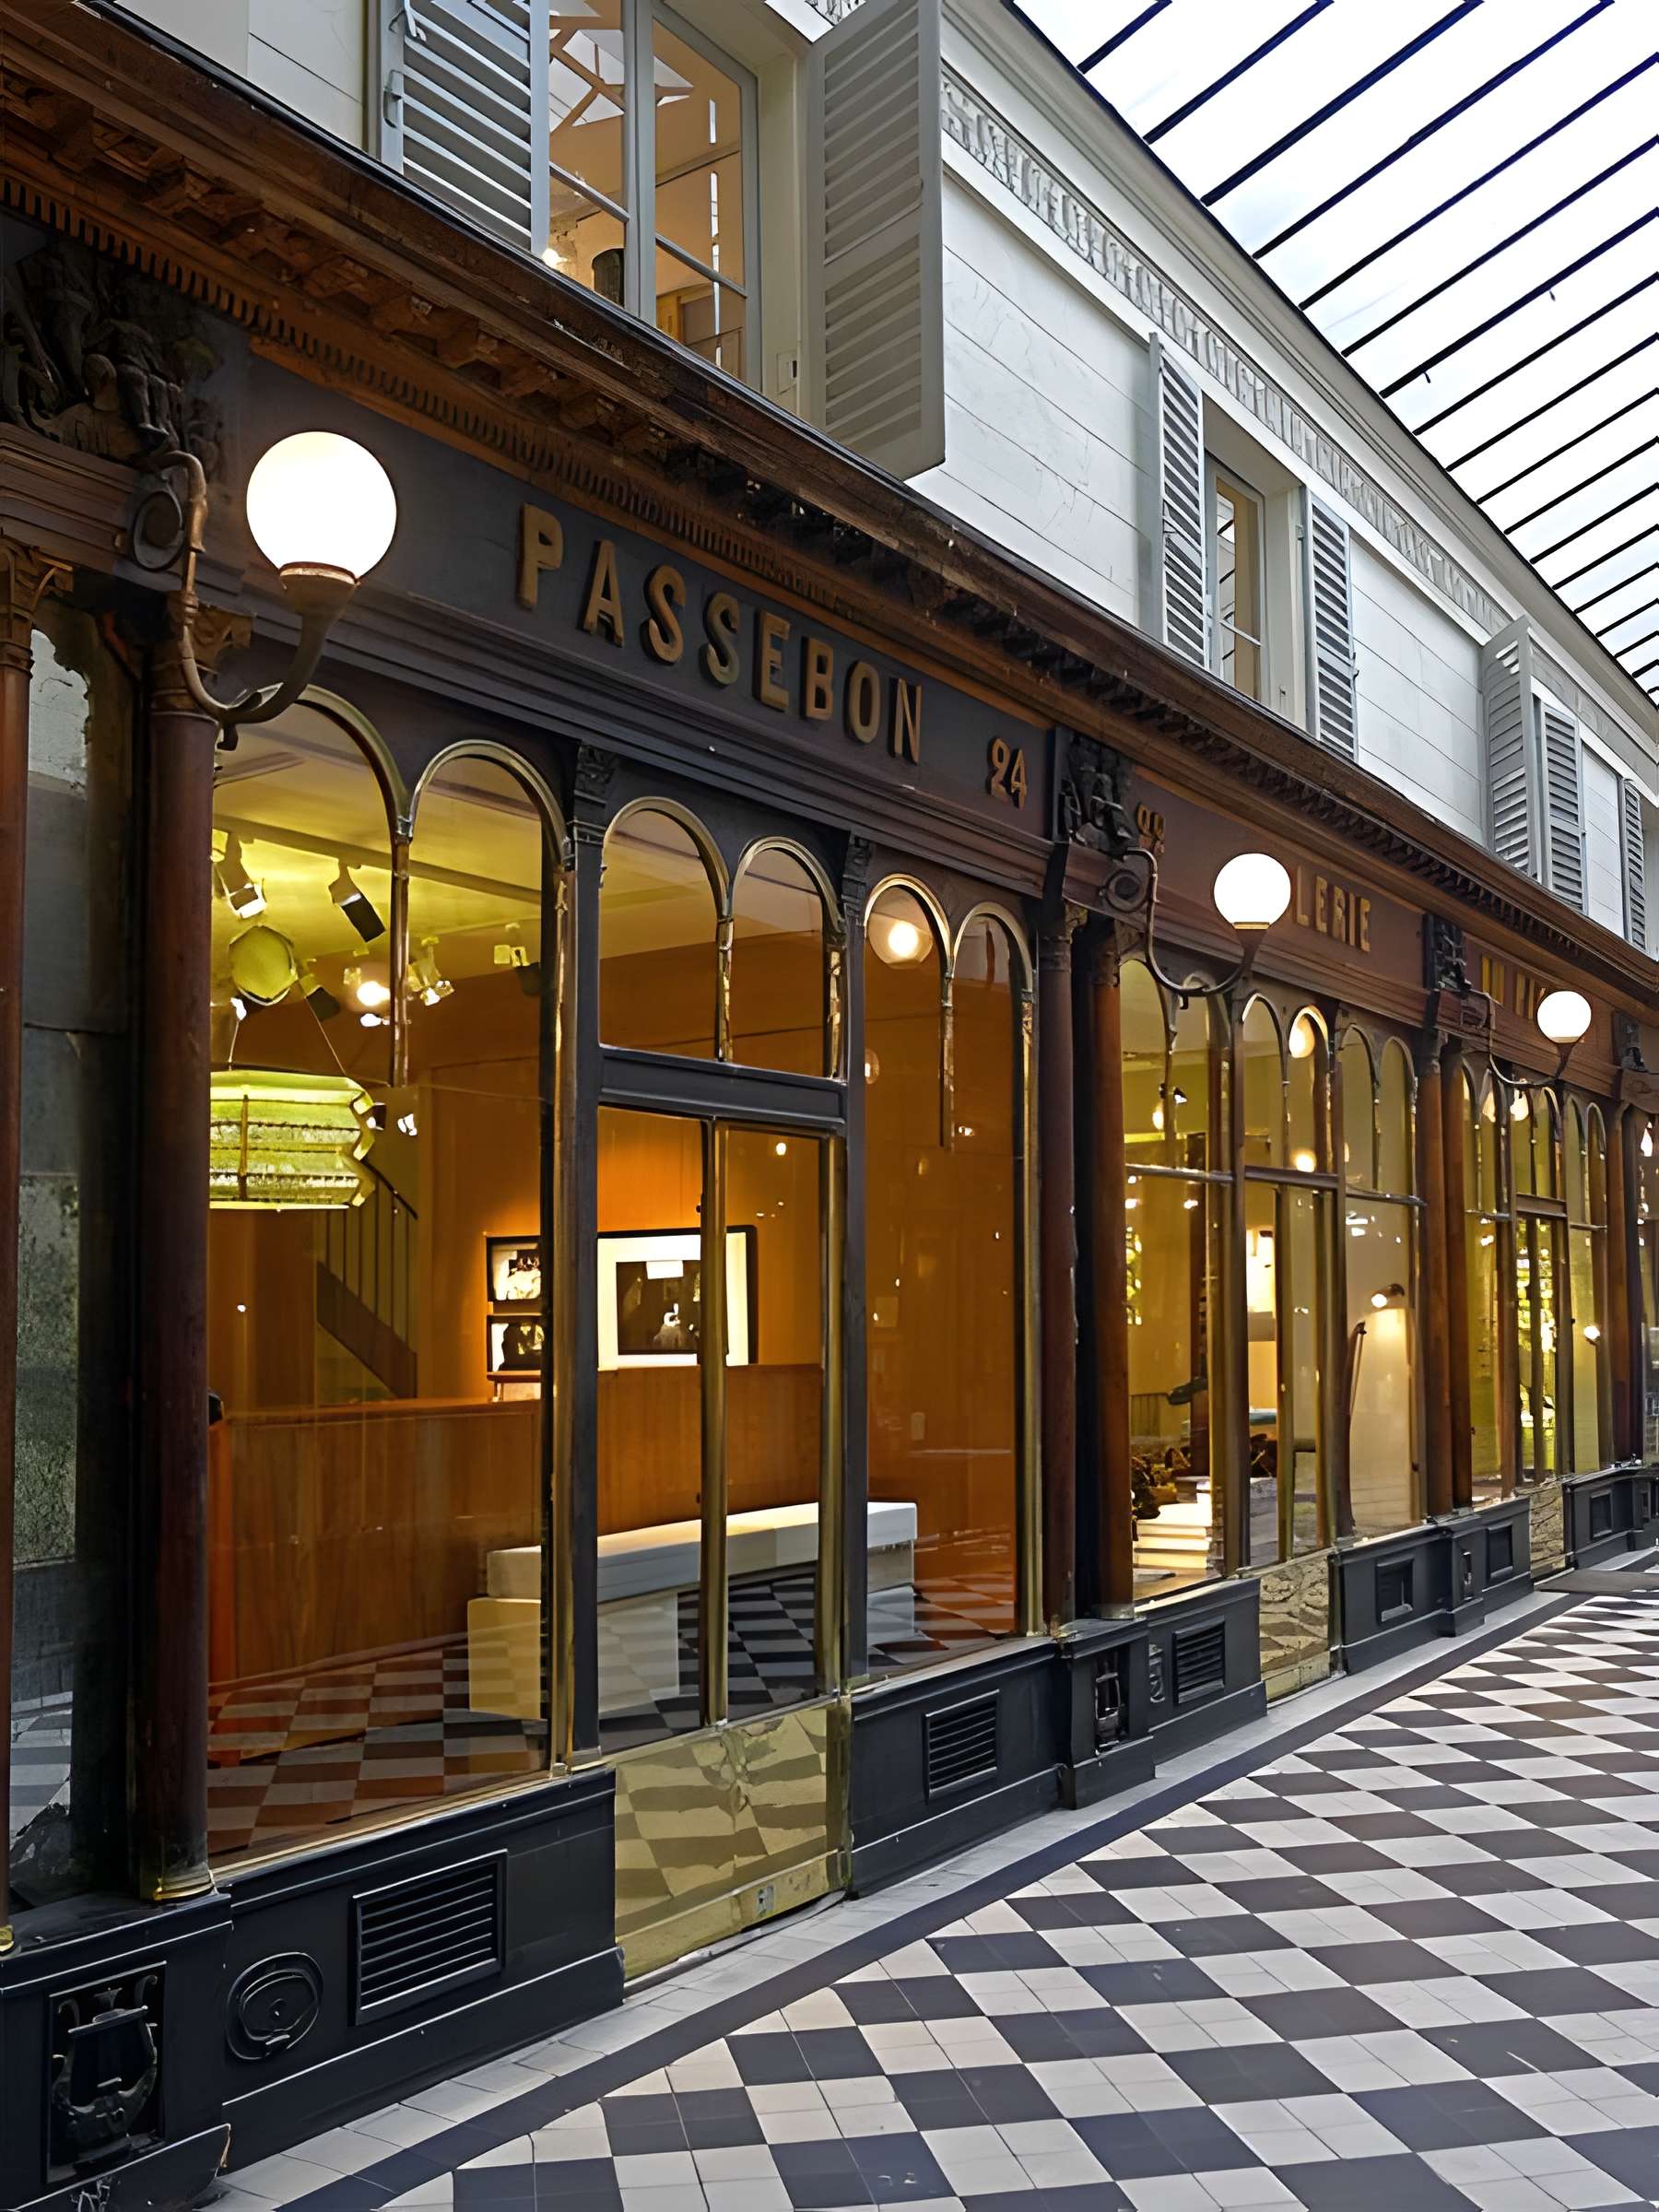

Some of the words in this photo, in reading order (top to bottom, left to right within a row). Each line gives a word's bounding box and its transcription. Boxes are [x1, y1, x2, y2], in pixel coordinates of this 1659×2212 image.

[518, 502, 922, 764] PASSEBON
[987, 737, 1027, 811] 24
[1297, 865, 1371, 953] LERIE
